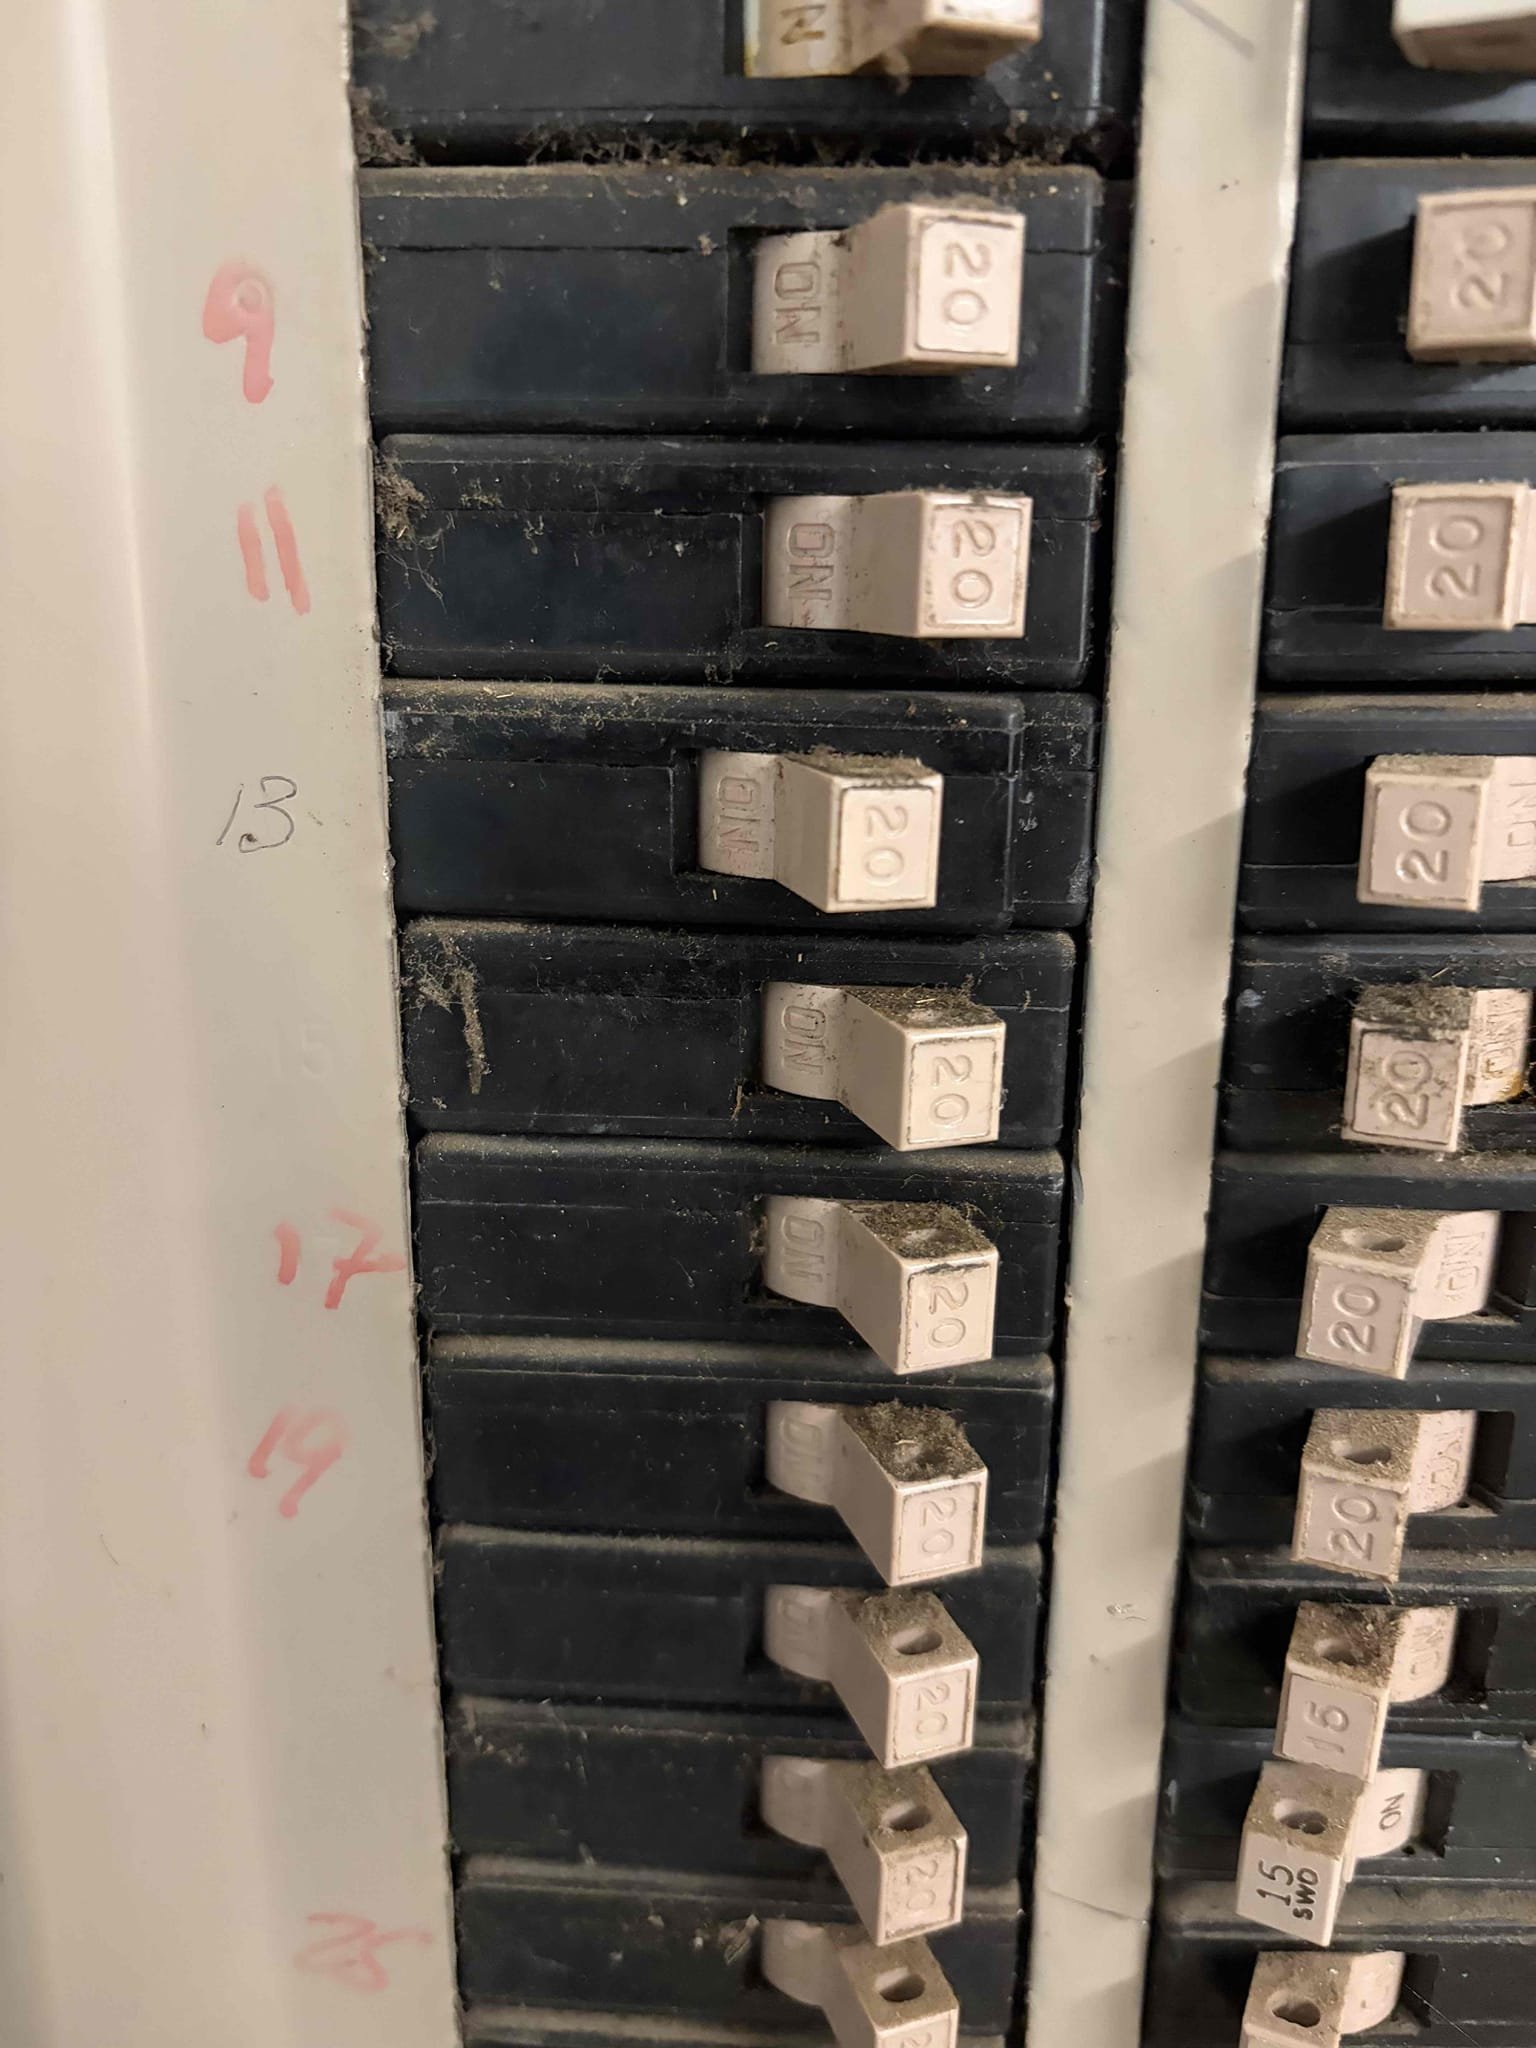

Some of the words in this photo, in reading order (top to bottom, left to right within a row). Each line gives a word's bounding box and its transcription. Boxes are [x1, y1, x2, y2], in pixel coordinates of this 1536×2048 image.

[774, 261, 821, 346] ON
[944, 242, 991, 326] 20
[1456, 220, 1513, 312] 20
[202, 256, 276, 405] 9
[785, 522, 835, 601] ON
[951, 518, 996, 609] 20
[1427, 513, 1486, 600] 20
[215, 775, 298, 853] 13
[717, 776, 761, 855] ON
[863, 804, 908, 888] 20
[1395, 799, 1453, 884] 20
[781, 1004, 827, 1076] ON
[928, 1053, 974, 1127] 20
[1378, 1048, 1433, 1130] 20
[273, 1207, 406, 1311] 17
[781, 1215, 826, 1284] ON
[928, 1281, 969, 1349] 20
[1327, 1281, 1381, 1355] 20
[246, 1405, 353, 1520] 19
[920, 1496, 957, 1560] 20
[1326, 1493, 1378, 1562] 20
[916, 1681, 951, 1738] 20
[1379, 1792, 1405, 1832] ON
[906, 1858, 939, 1911] 20
[1256, 1859, 1294, 1907] 15
